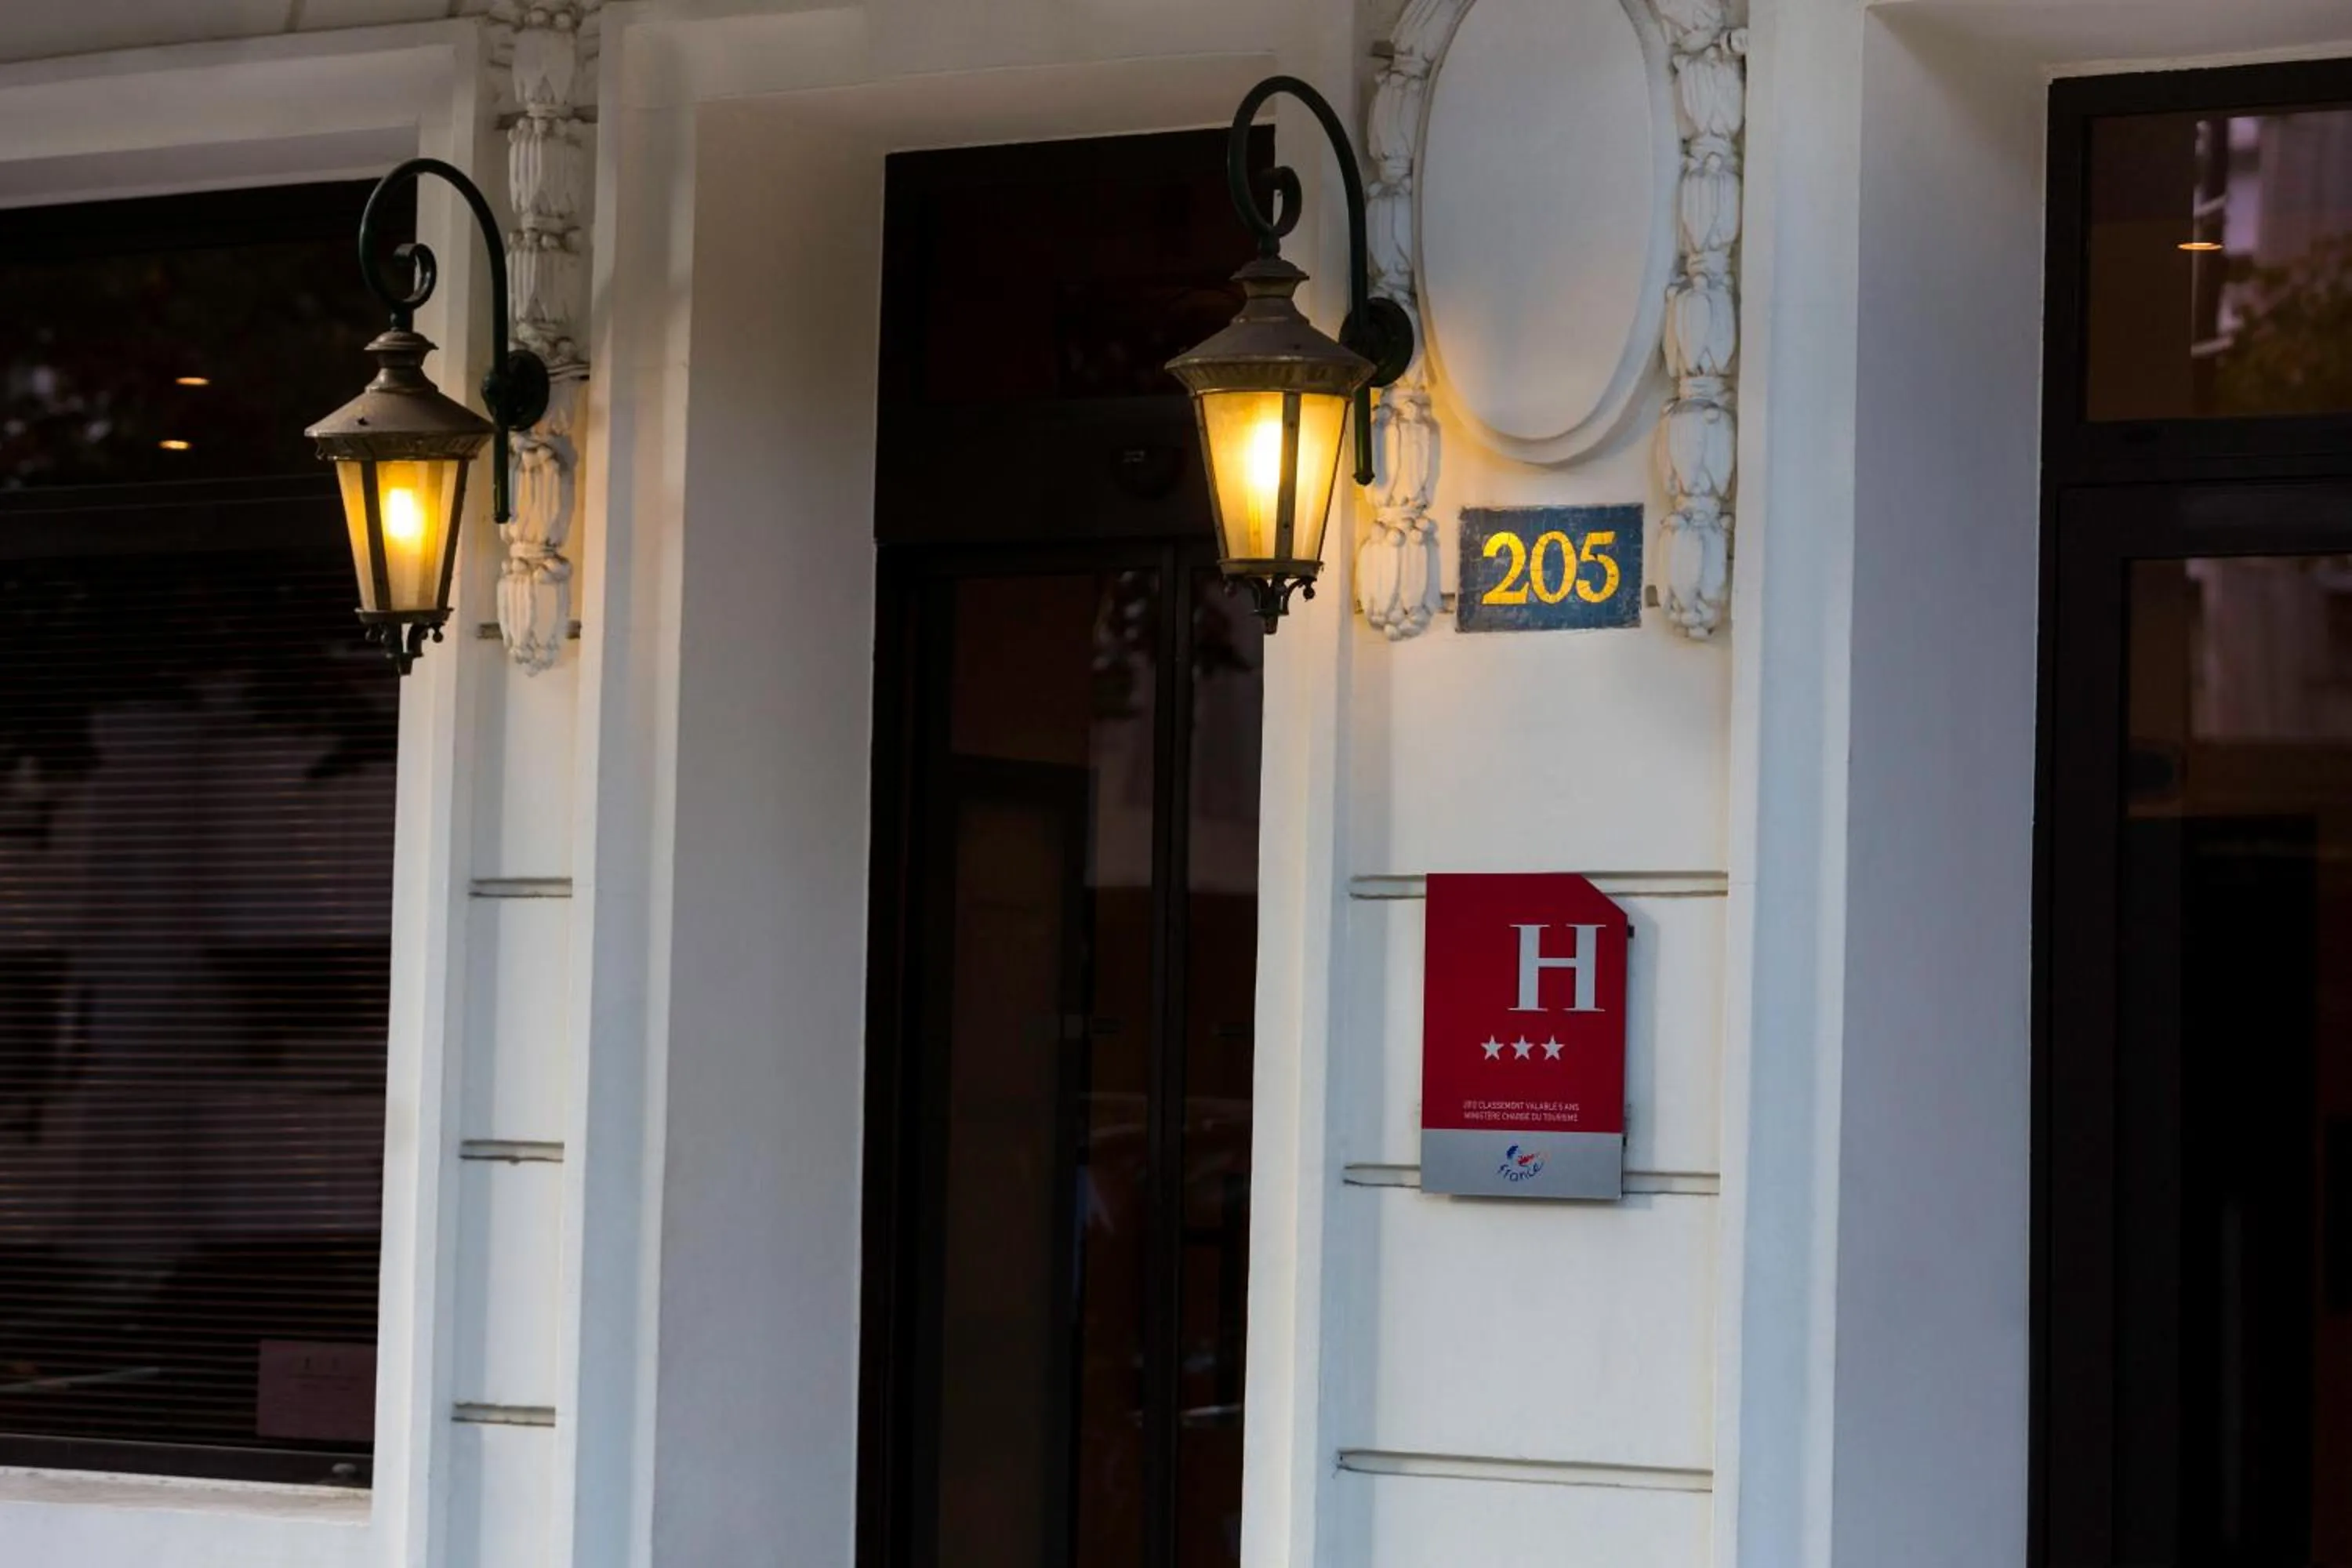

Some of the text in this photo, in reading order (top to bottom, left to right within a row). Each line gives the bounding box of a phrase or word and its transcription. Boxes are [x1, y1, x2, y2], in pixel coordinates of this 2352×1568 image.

[1481, 530, 1620, 604] 205
[1508, 924, 1606, 1012] H
[1525, 1102, 1558, 1112] VALABLE
[1565, 1102, 1581, 1112] ANS
[1531, 1112, 1542, 1122] DU
